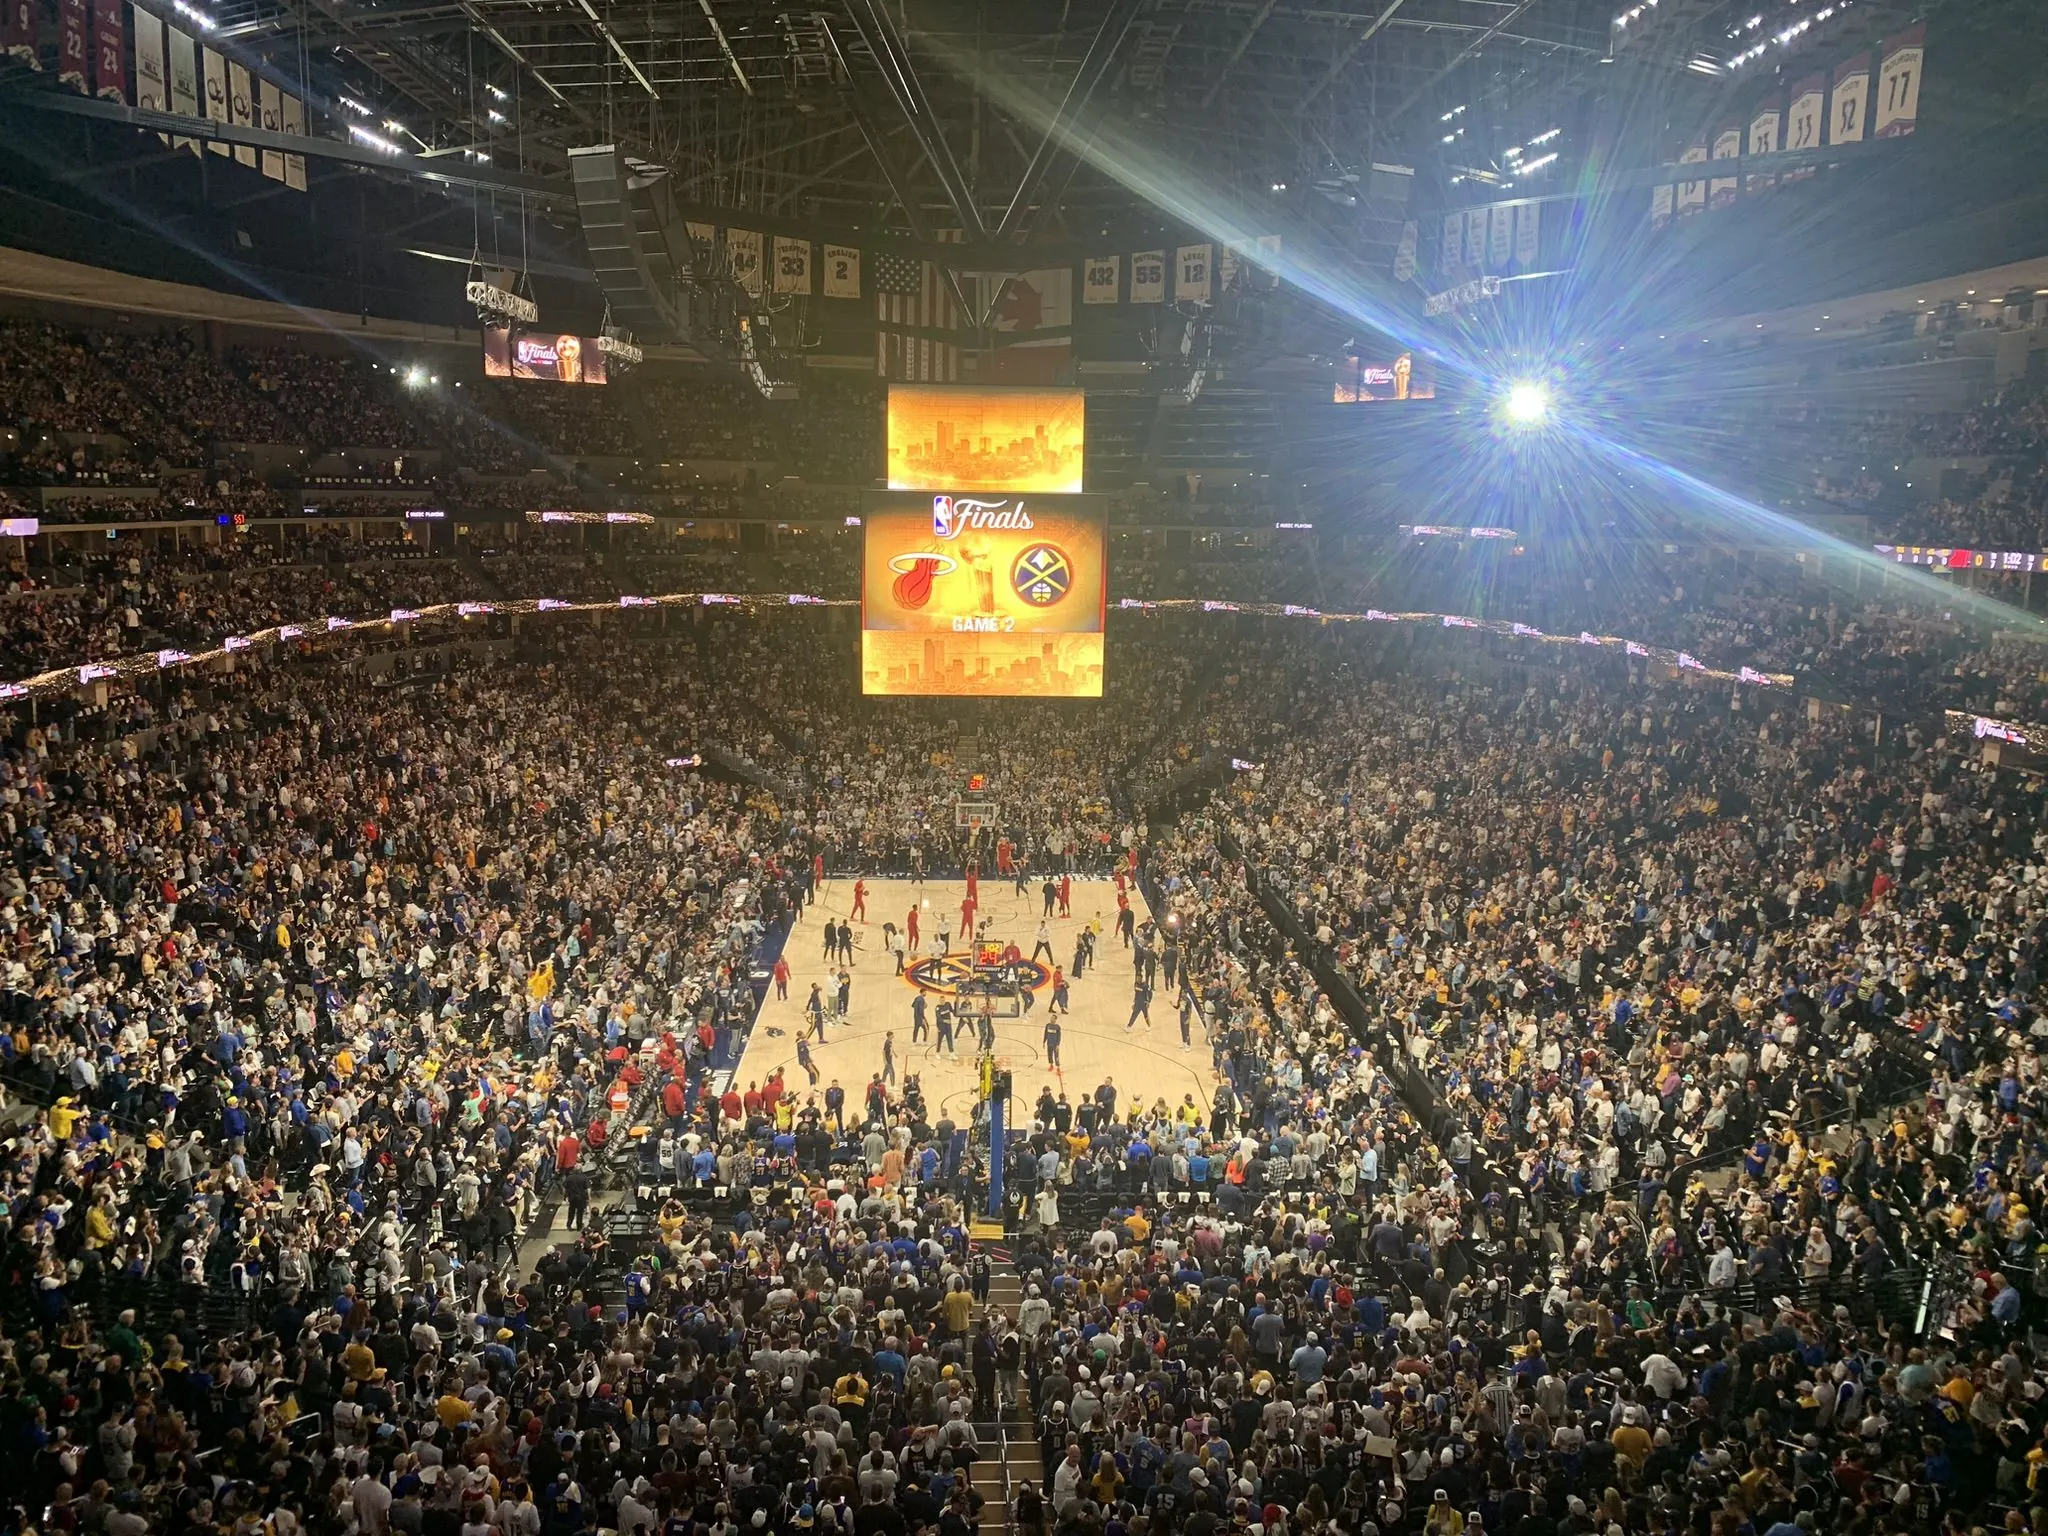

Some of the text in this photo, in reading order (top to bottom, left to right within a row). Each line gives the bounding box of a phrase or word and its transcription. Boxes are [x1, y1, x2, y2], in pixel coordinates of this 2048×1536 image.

[67, 30, 82, 59] 22
[781, 256, 805, 277] 33
[836, 261, 848, 281] 2
[1088, 266, 1114, 286] 432
[1135, 265, 1161, 285] 55
[1183, 264, 1205, 284] 12
[526, 343, 559, 362] Finals
[942, 499, 1034, 540] Finals
[2003, 552, 2022, 565] 1:02
[952, 616, 1016, 633] GAME 2
[979, 951, 997, 966] 24
[1347, 1449, 1362, 1468] 15
[1157, 1493, 1175, 1509] 15
